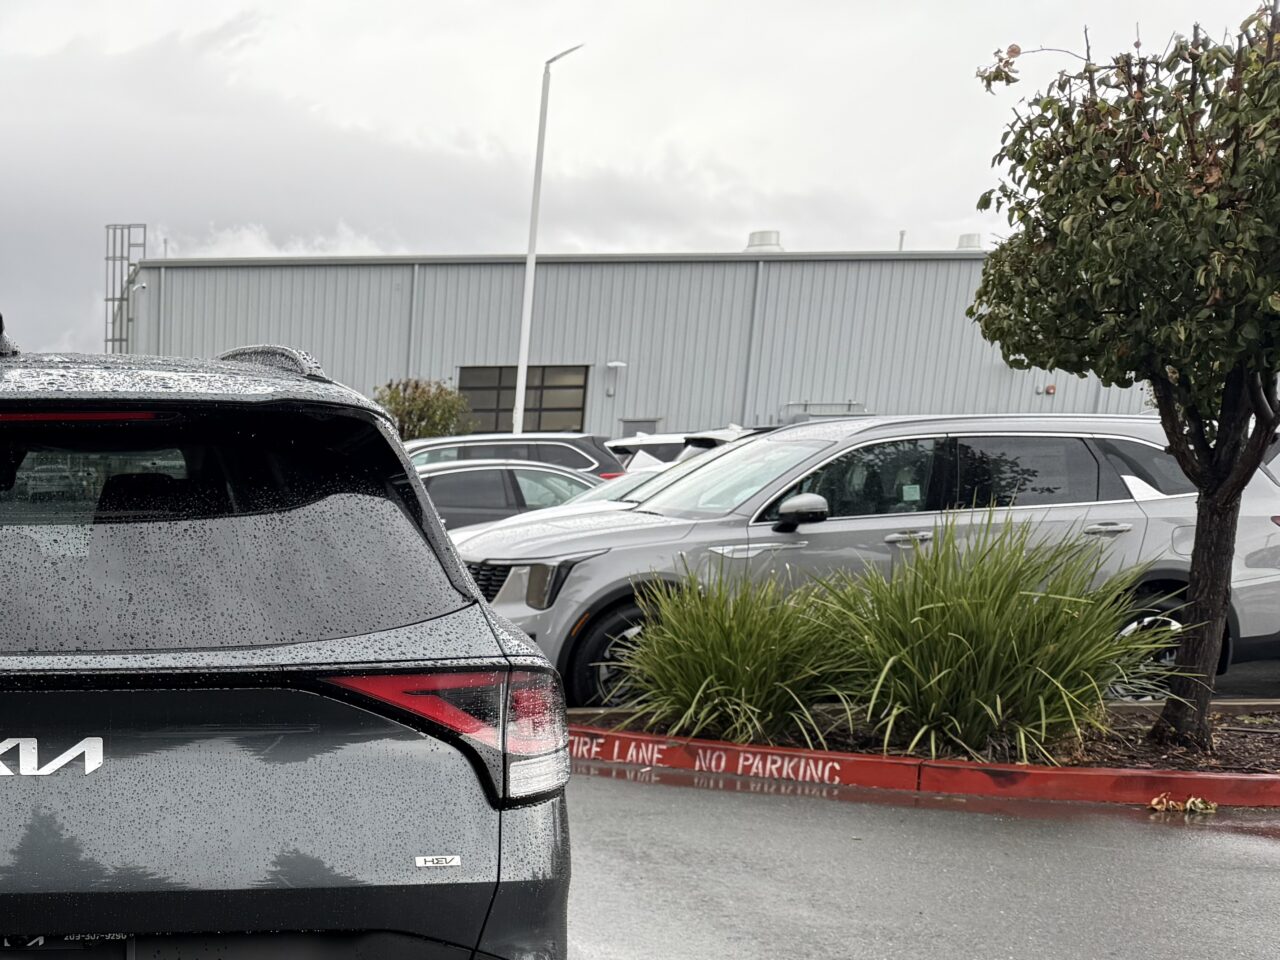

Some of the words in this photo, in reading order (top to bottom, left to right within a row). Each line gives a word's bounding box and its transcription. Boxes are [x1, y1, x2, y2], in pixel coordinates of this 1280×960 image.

[568, 735, 605, 760] IRE
[613, 740, 671, 767] LANE
[695, 749, 727, 773] NO
[737, 752, 841, 785] PARKING
[422, 857, 456, 866] HEV
